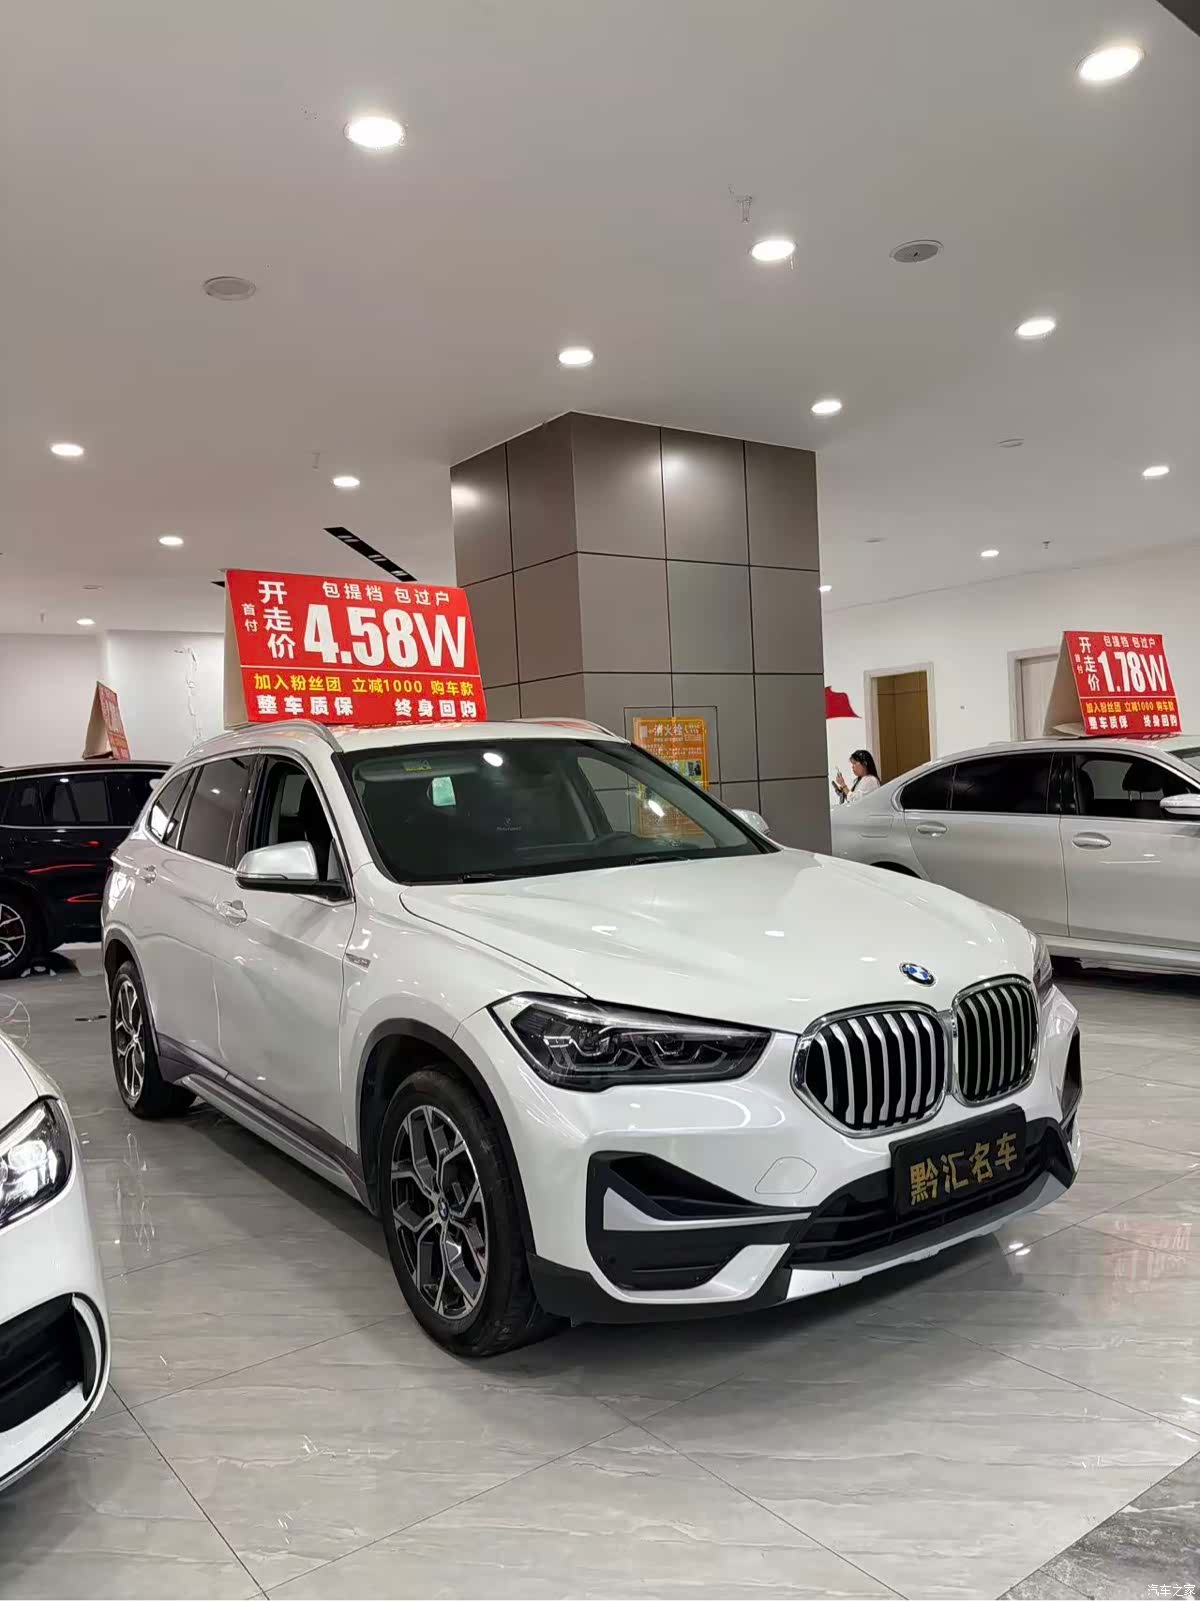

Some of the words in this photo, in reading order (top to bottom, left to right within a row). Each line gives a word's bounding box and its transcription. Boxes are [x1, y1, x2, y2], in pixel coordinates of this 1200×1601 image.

[322, 581, 384, 602] 包提档
[394, 587, 450, 606] 包过户
[241, 602, 259, 633] 首付
[258, 580, 296, 659] 开走价
[303, 603, 467, 668] 4.58W
[253, 674, 342, 693] 加入粉丝团
[352, 677, 423, 694] 立减1000
[431, 680, 475, 697] 购车款
[1078, 636, 1101, 692] 开走价
[1097, 650, 1168, 693] 1.78W
[256, 695, 354, 716] 整车质保
[394, 698, 477, 719] 终身回购
[910, 1131, 1018, 1206] 黔汇名车
